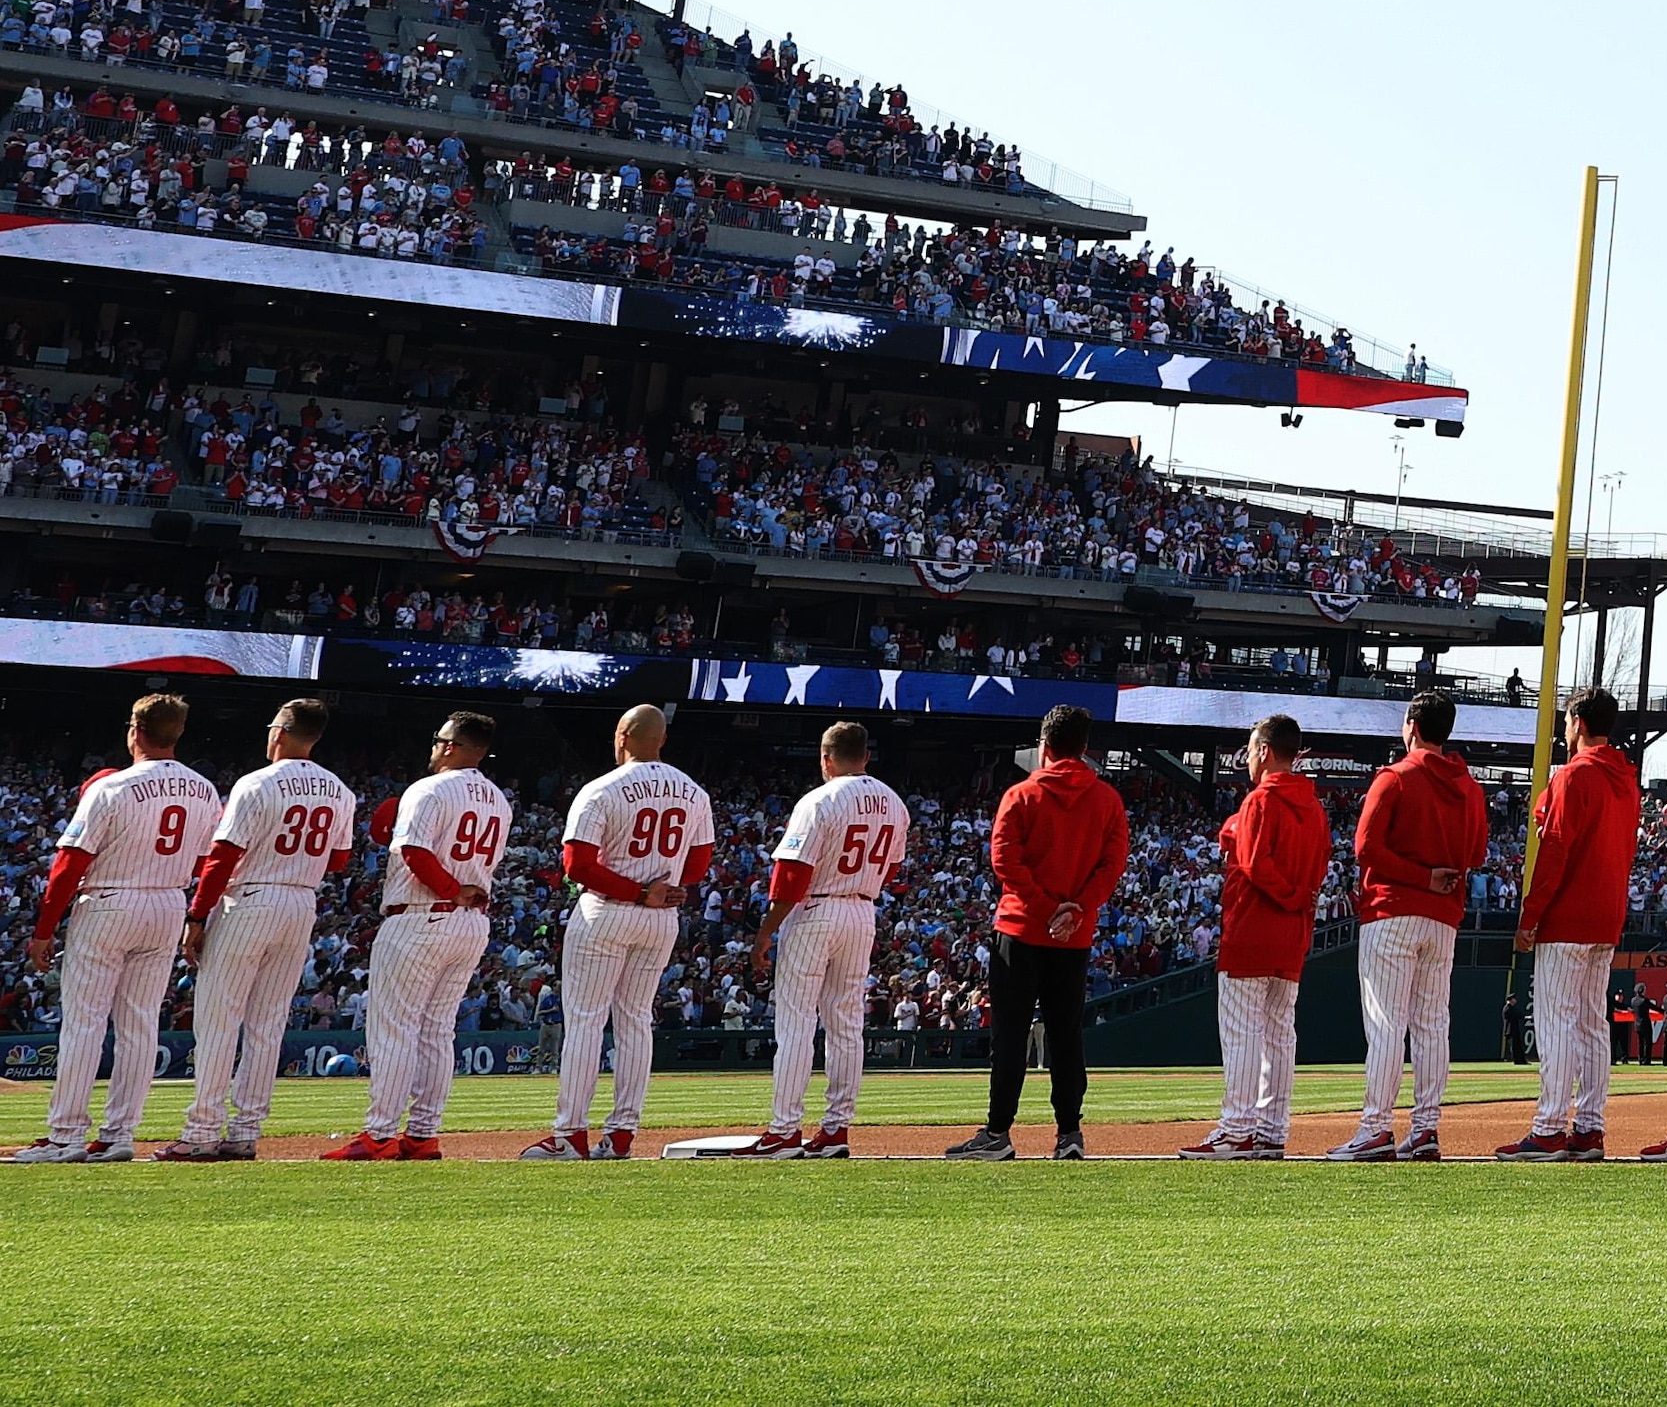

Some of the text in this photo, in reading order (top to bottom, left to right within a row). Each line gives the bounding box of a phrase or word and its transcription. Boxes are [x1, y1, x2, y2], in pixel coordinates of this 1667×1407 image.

[131, 776, 214, 805] DICKERSON
[276, 776, 343, 803] FIGUEROA
[467, 780, 496, 806] PEÑA
[621, 784, 697, 805] GONZALEZ
[857, 795, 888, 816] LONG
[155, 805, 187, 856] 9
[274, 805, 334, 857] 38
[450, 810, 501, 867] 94
[628, 807, 687, 858] 96
[837, 824, 895, 876] 54
[461, 1045, 494, 1076] 10
